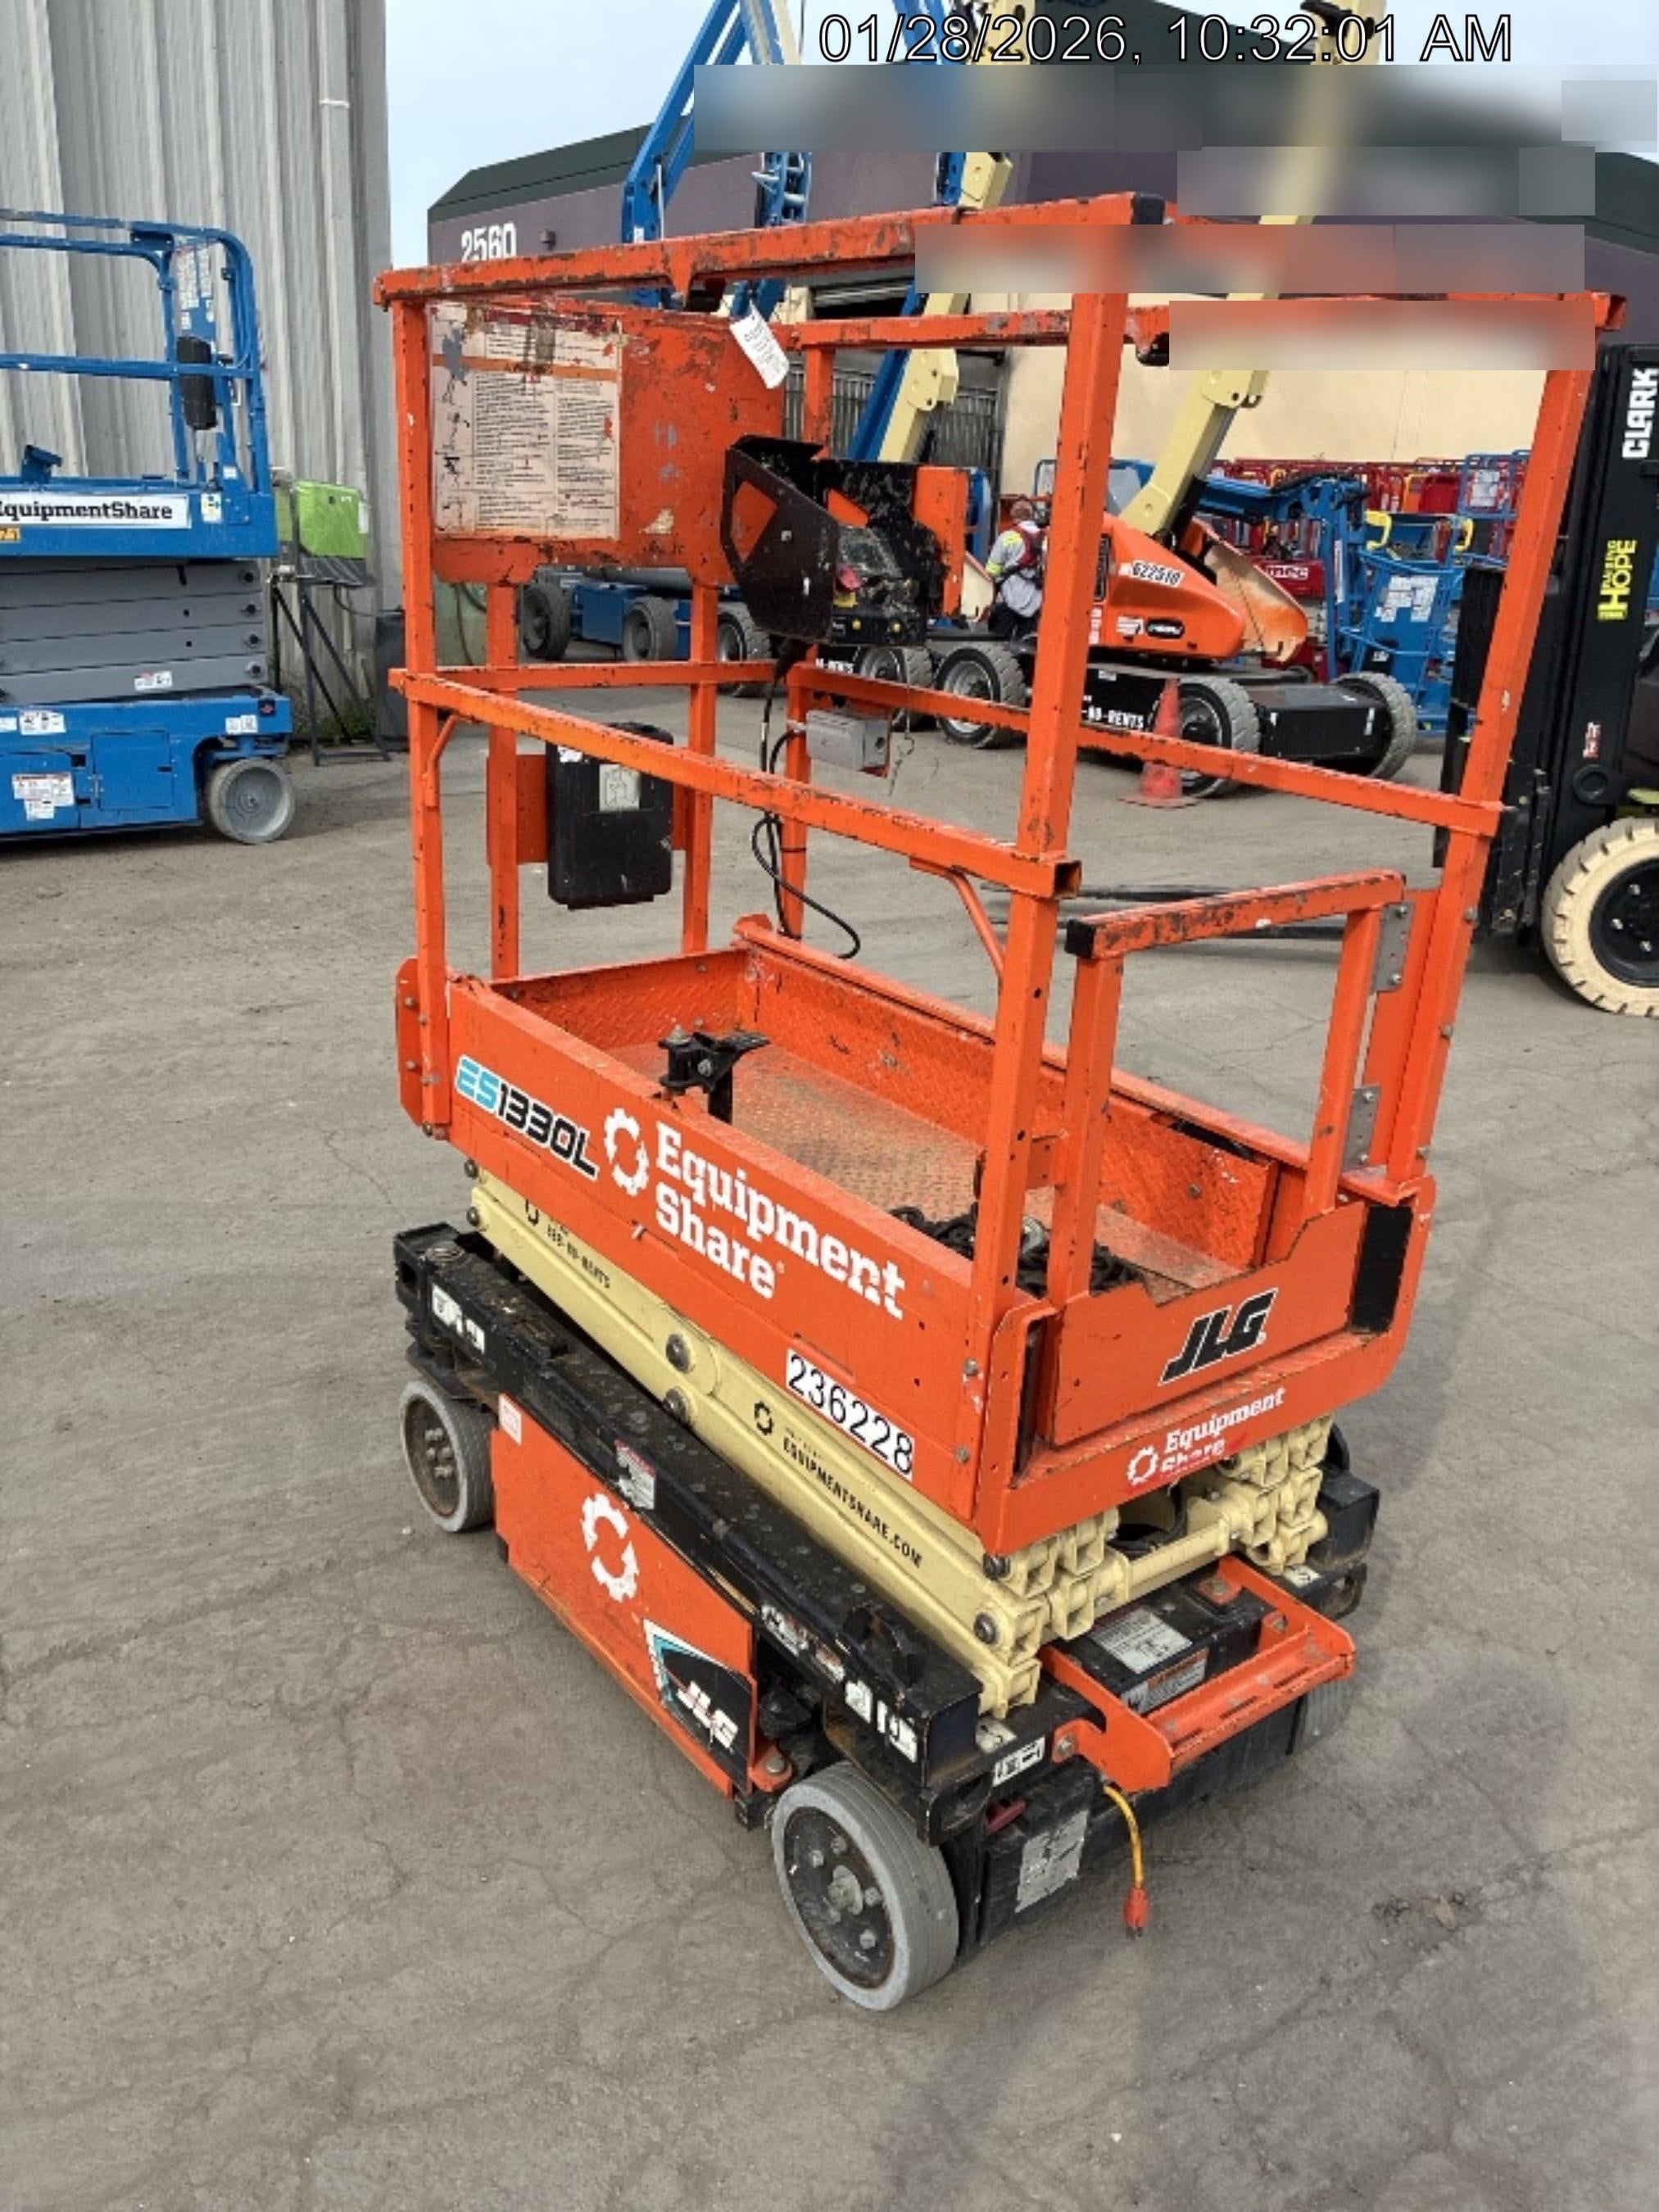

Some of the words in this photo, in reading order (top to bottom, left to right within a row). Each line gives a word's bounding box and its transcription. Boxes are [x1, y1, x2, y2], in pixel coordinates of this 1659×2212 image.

[460, 220, 517, 262] 2560
[1622, 368, 1659, 458] CLARK
[456, 1054, 599, 1181] ES1330L
[656, 1121, 905, 1320] Equipment
[656, 1181, 775, 1299] Share
[1159, 1289, 1278, 1385] JLG
[788, 1353, 913, 1475] 236228
[1164, 1388, 1285, 1454] Equipment
